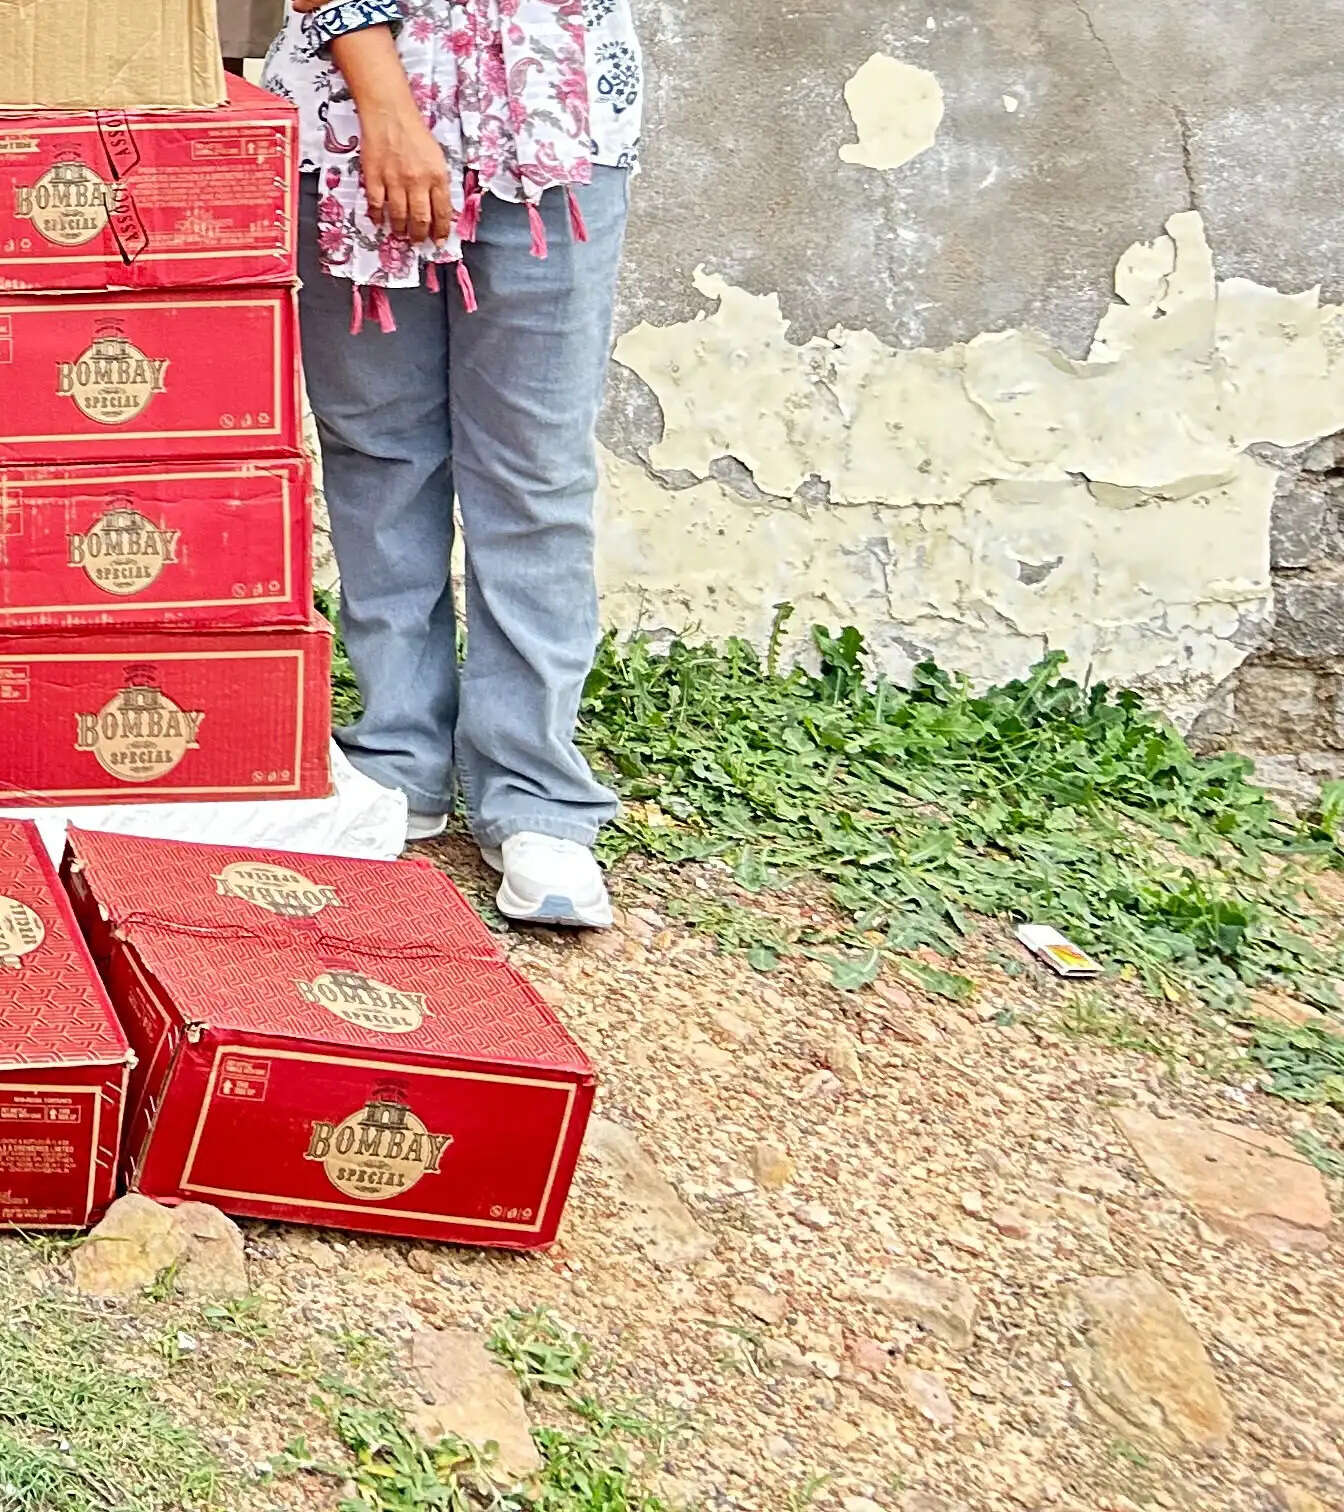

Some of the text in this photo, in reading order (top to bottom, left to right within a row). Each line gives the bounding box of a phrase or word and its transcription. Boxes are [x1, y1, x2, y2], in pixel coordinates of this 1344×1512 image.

[58, 359, 168, 395] BOMBAY
[85, 394, 139, 409] SPECIAL
[68, 530, 179, 566] BOMBAY
[96, 566, 151, 580] SPECIAL
[78, 712, 203, 747] BOMBAY
[110, 751, 172, 764] SPECIAL
[216, 877, 343, 908] BOMBAY
[297, 980, 435, 1016] BOMBAY
[343, 1010, 410, 1026] SPECIAL
[307, 1122, 451, 1172] BOMBAY
[336, 1168, 404, 1186] SPECIAL
